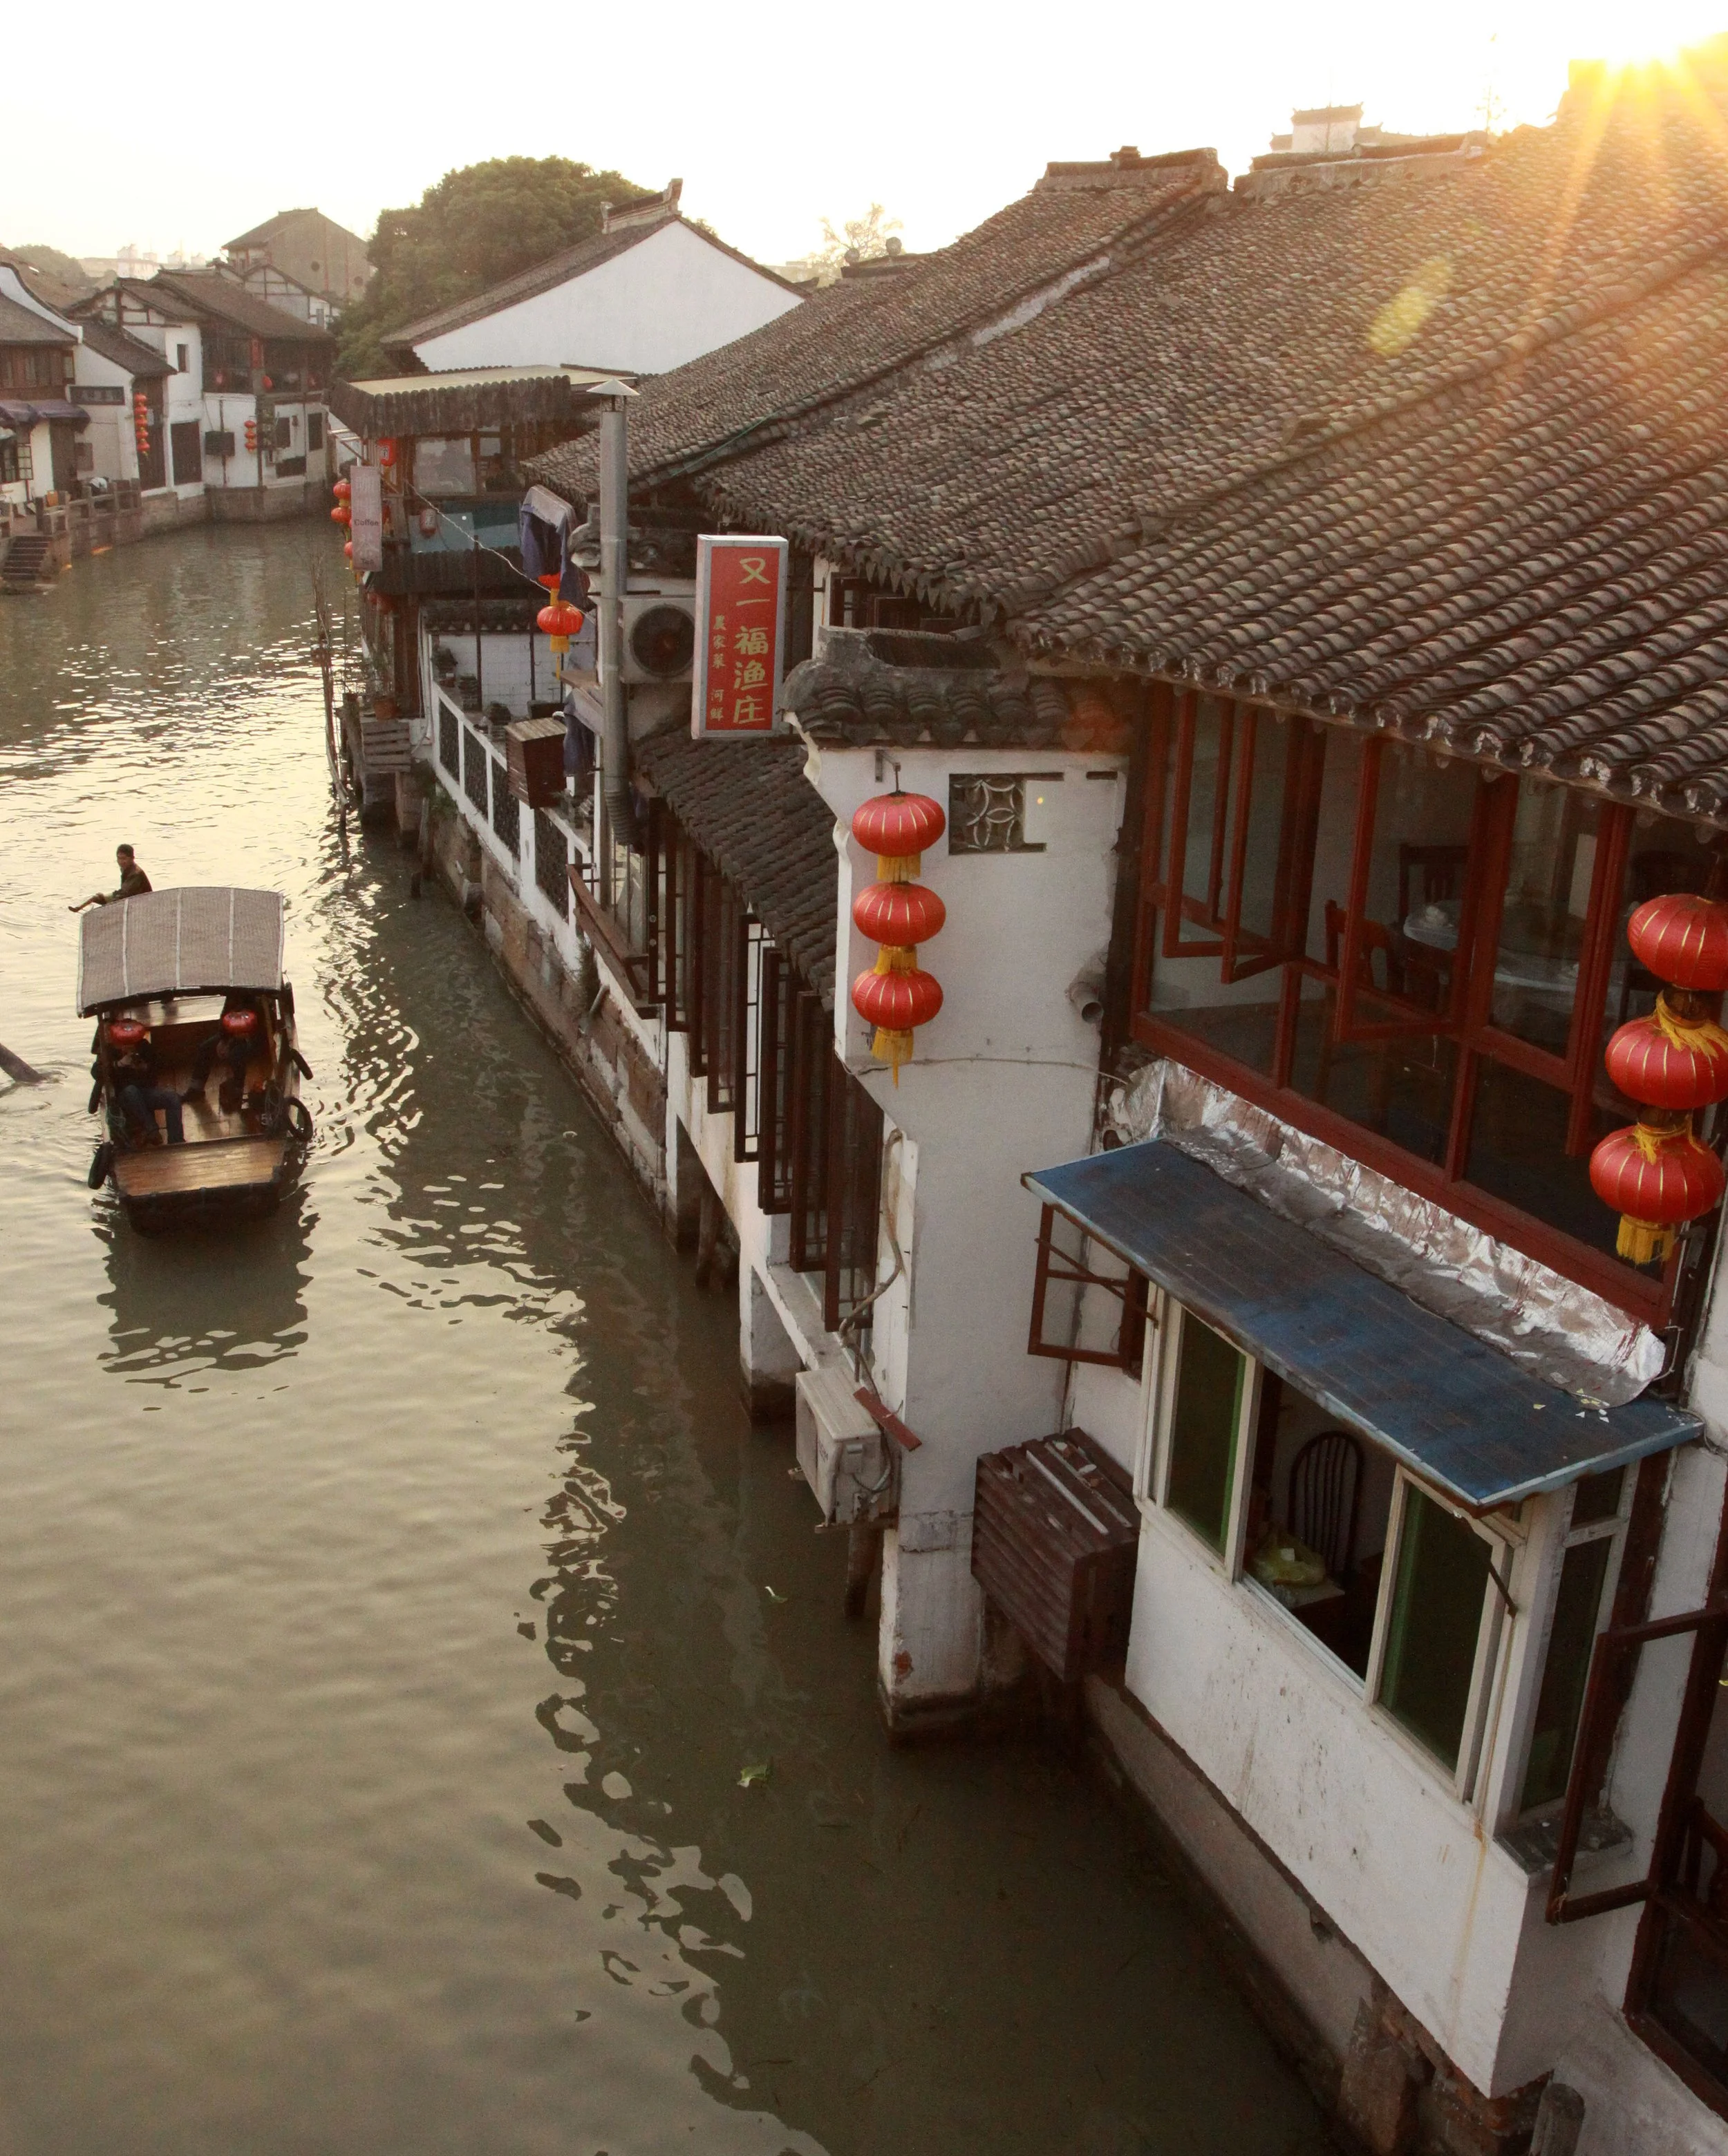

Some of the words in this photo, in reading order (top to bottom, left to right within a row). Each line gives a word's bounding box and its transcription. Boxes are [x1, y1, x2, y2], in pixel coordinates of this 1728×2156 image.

[733, 557, 771, 724] 又一福渔庄
